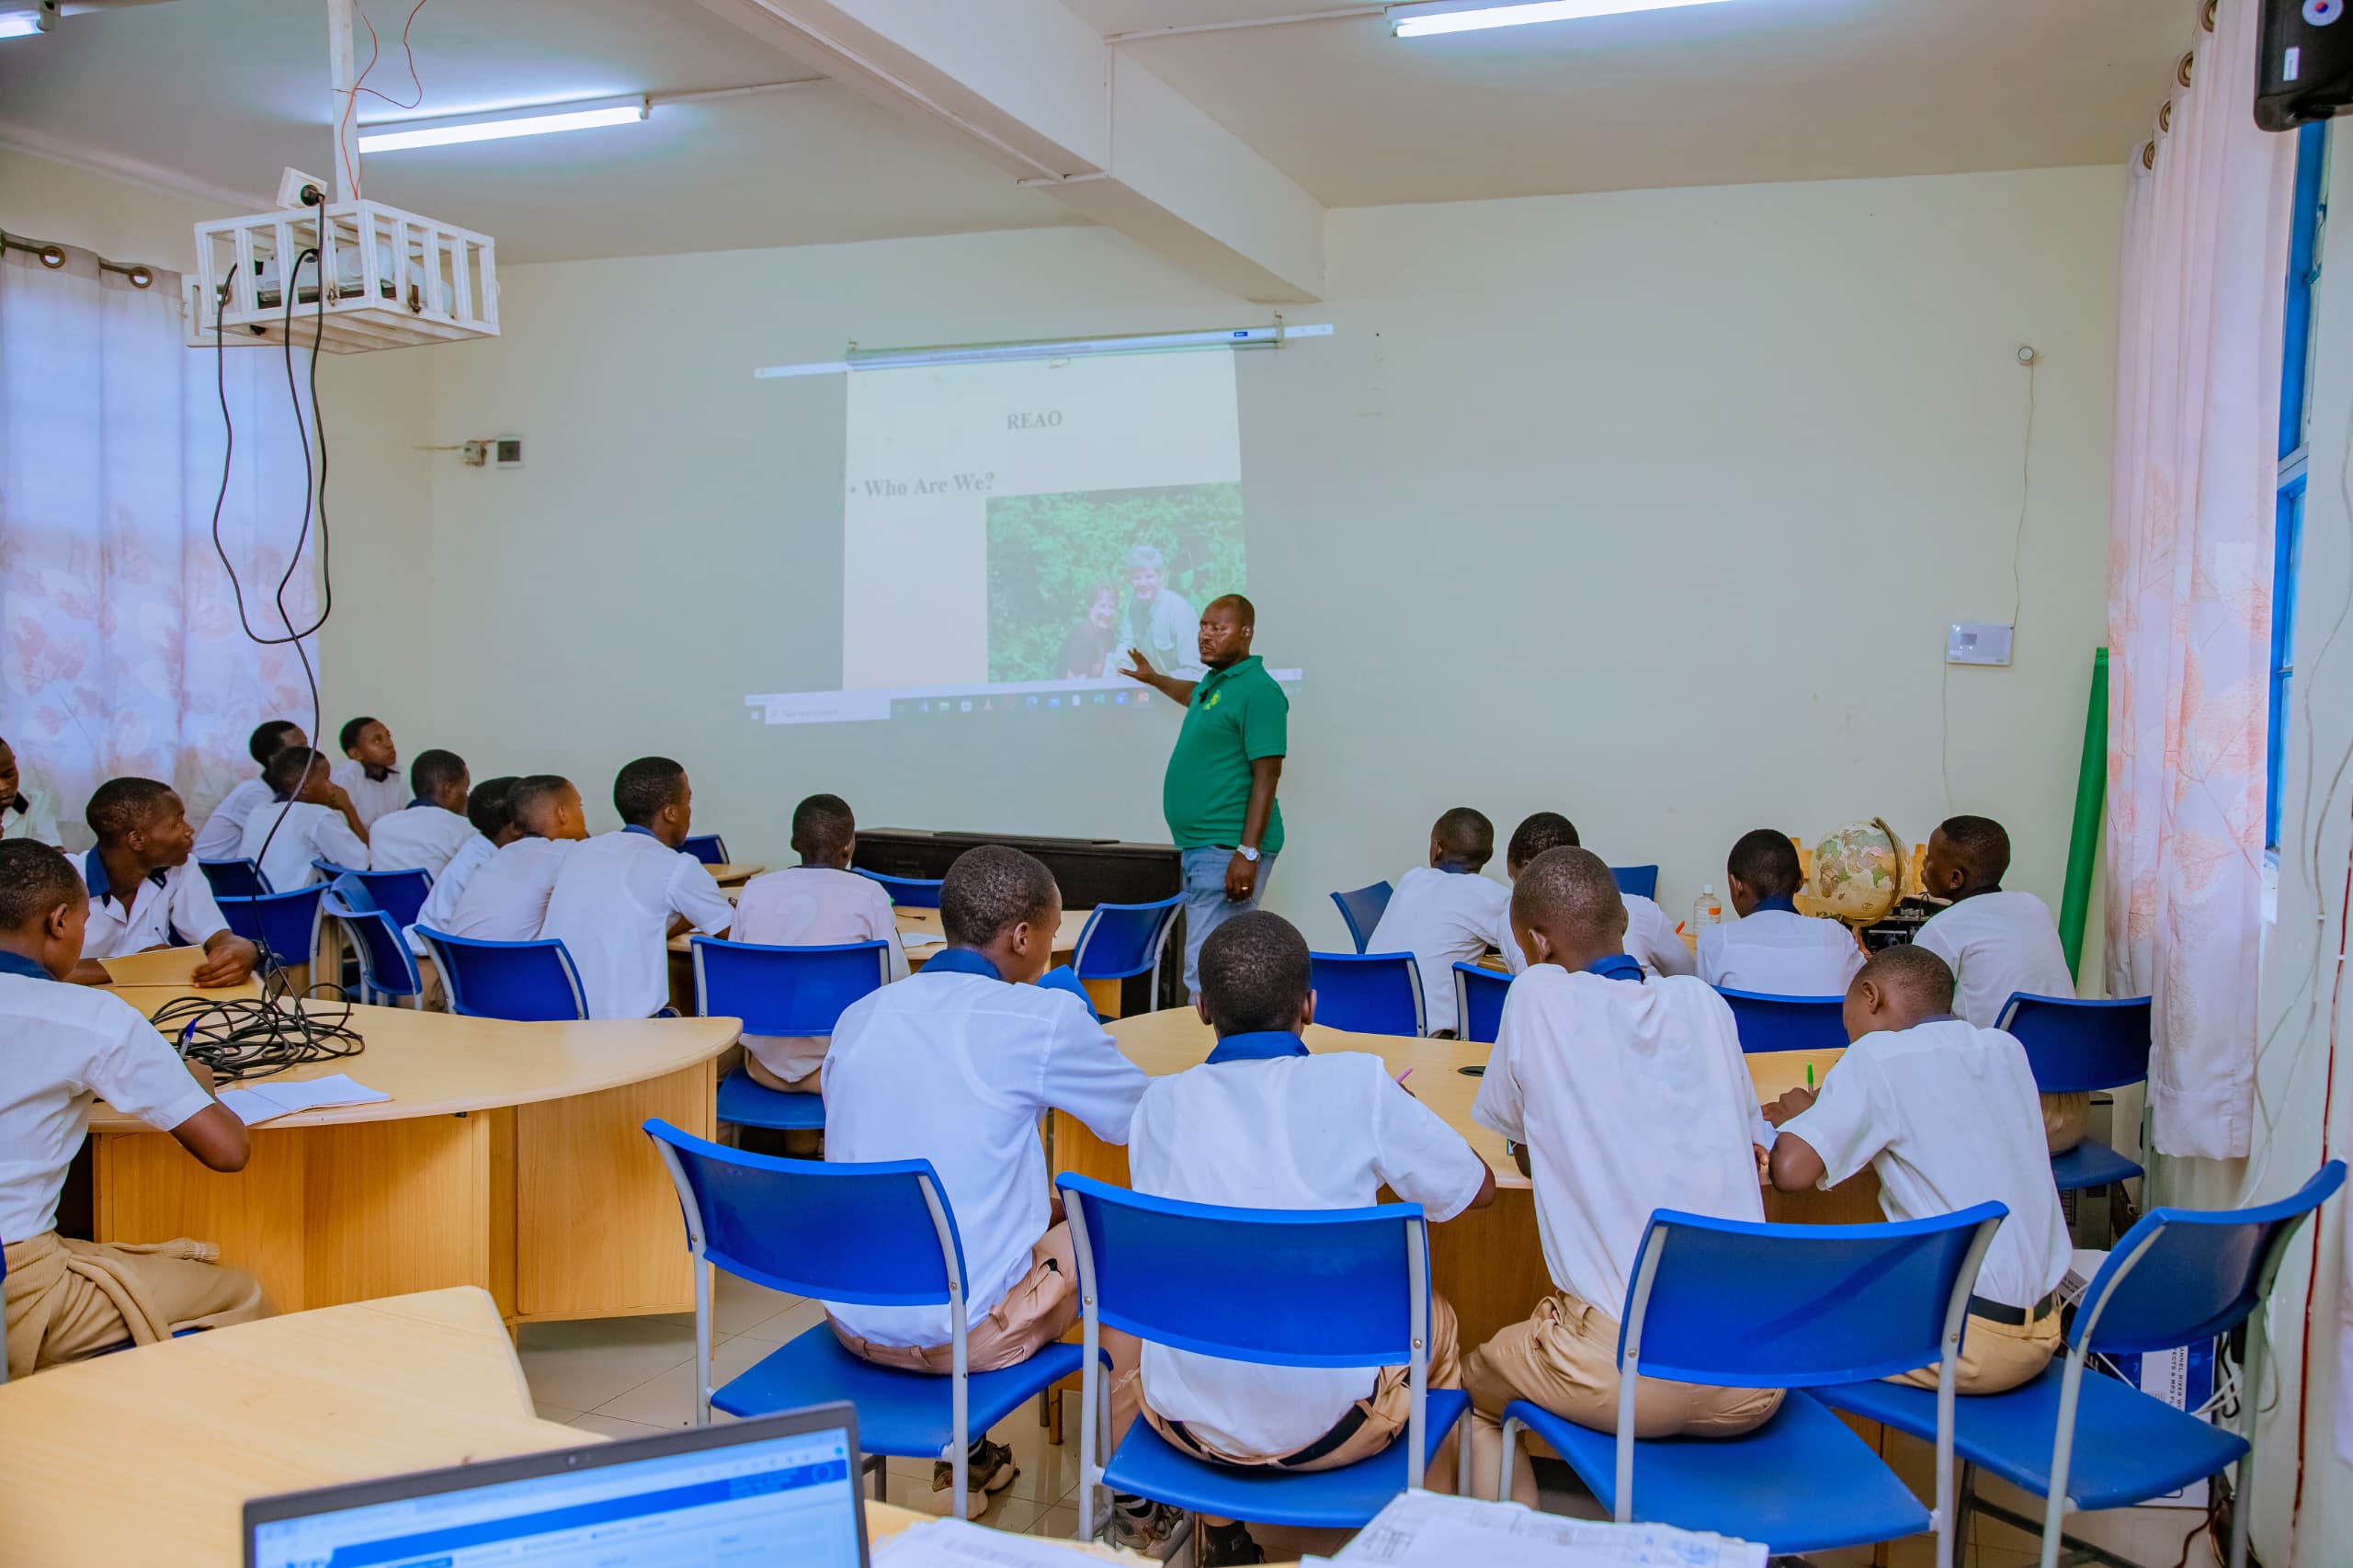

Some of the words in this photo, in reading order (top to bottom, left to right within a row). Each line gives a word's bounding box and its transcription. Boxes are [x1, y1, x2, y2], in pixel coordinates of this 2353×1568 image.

[1007, 410, 1063, 430] REAO
[864, 478, 907, 497] Who
[913, 477, 949, 494] Are
[953, 471, 995, 491] We?
